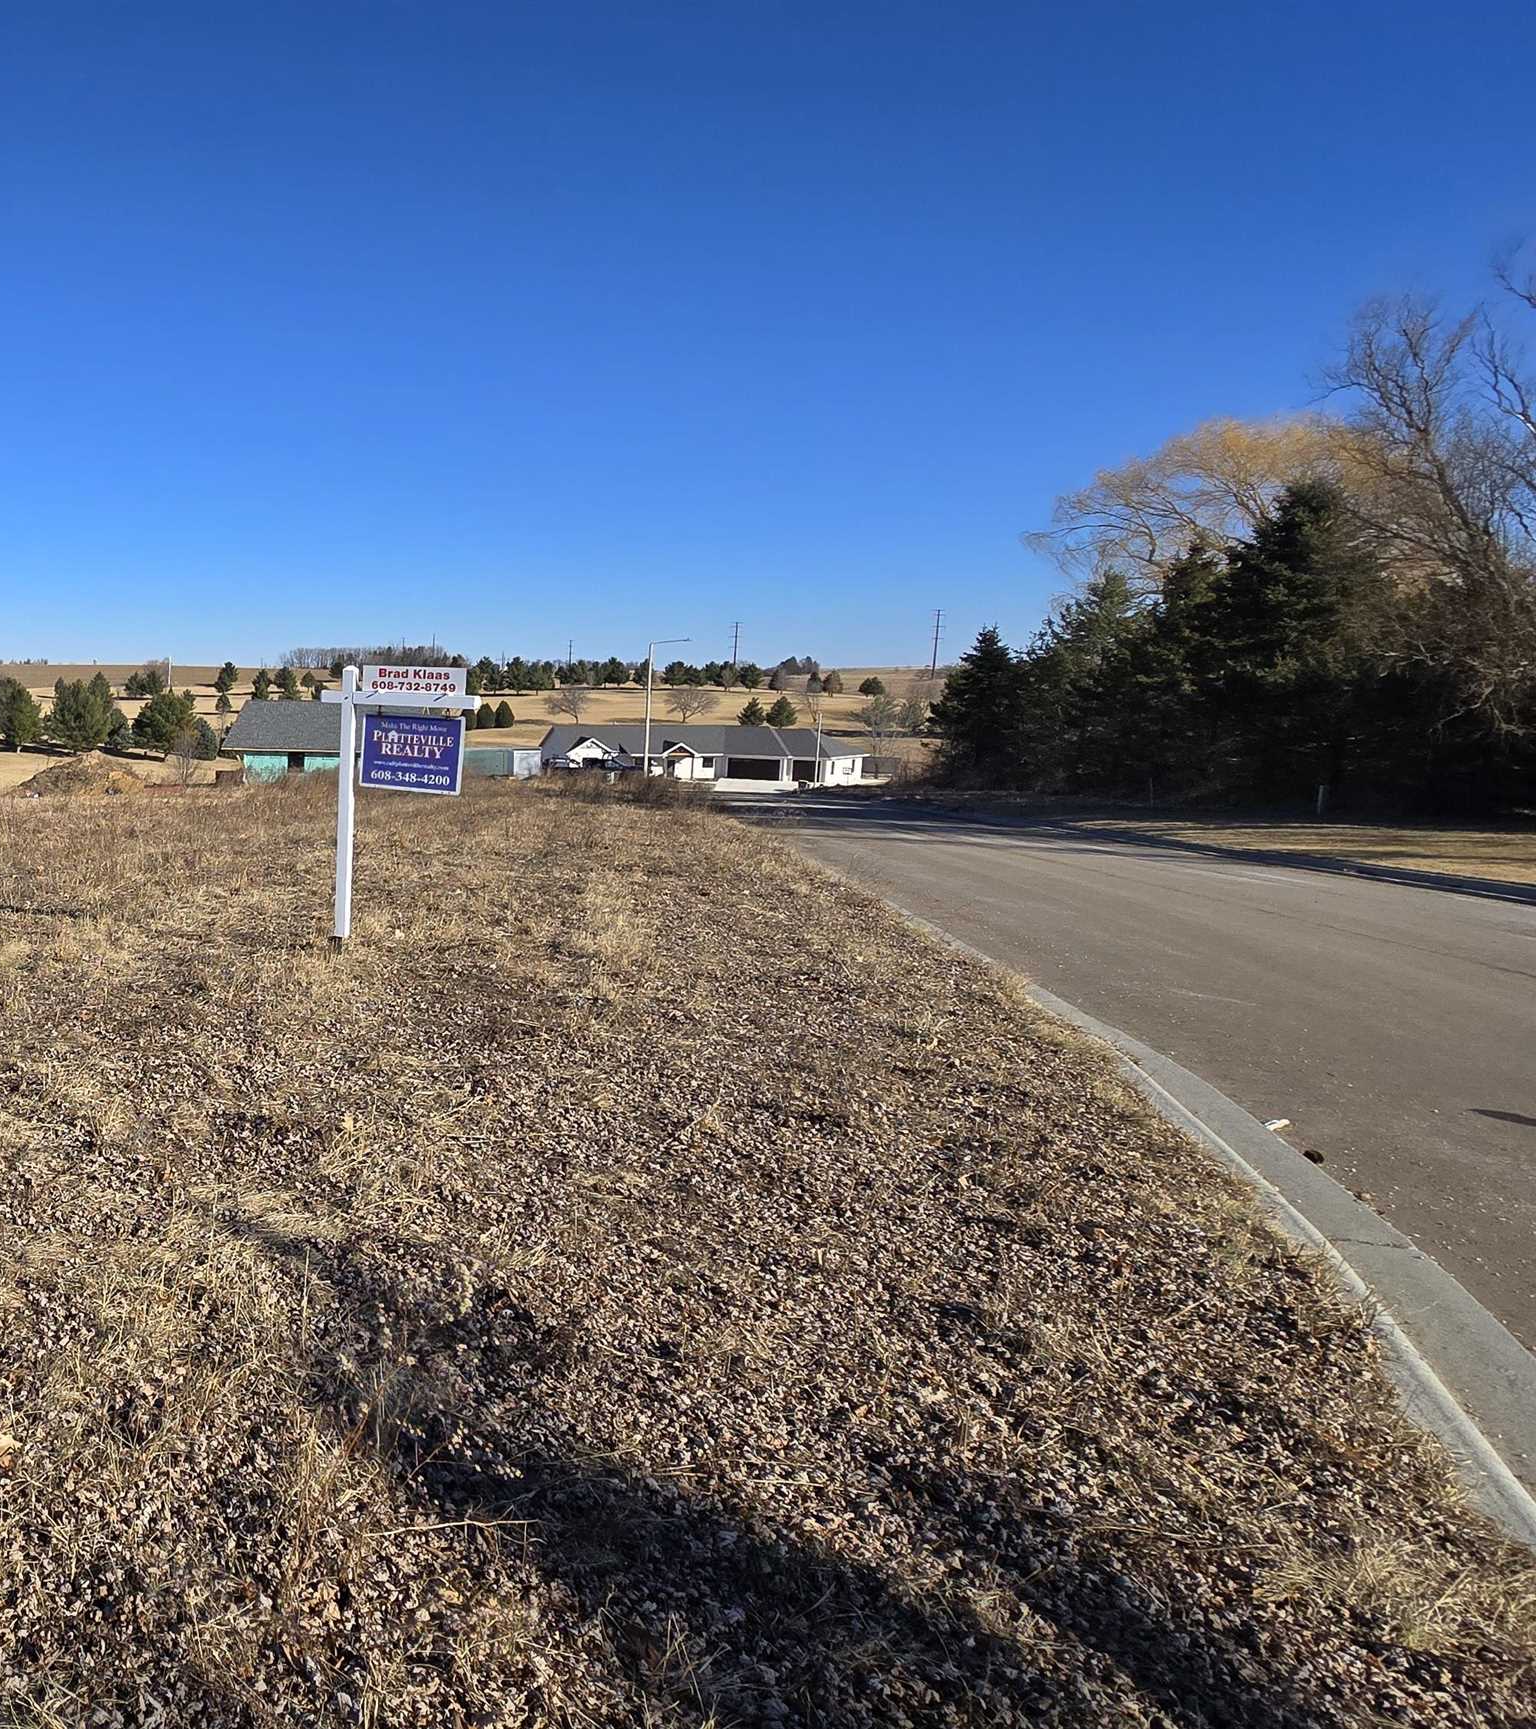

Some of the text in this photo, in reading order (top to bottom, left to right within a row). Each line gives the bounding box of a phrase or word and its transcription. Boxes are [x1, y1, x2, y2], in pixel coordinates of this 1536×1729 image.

[378, 668, 450, 680] Brad Klaas
[371, 681, 456, 692] 608-732-8749
[399, 722, 411, 730] The
[412, 723, 429, 731] Right
[373, 729, 454, 747] PLATTEVILLE
[381, 743, 444, 759] REALTY
[370, 769, 450, 786] 608-348-4200
